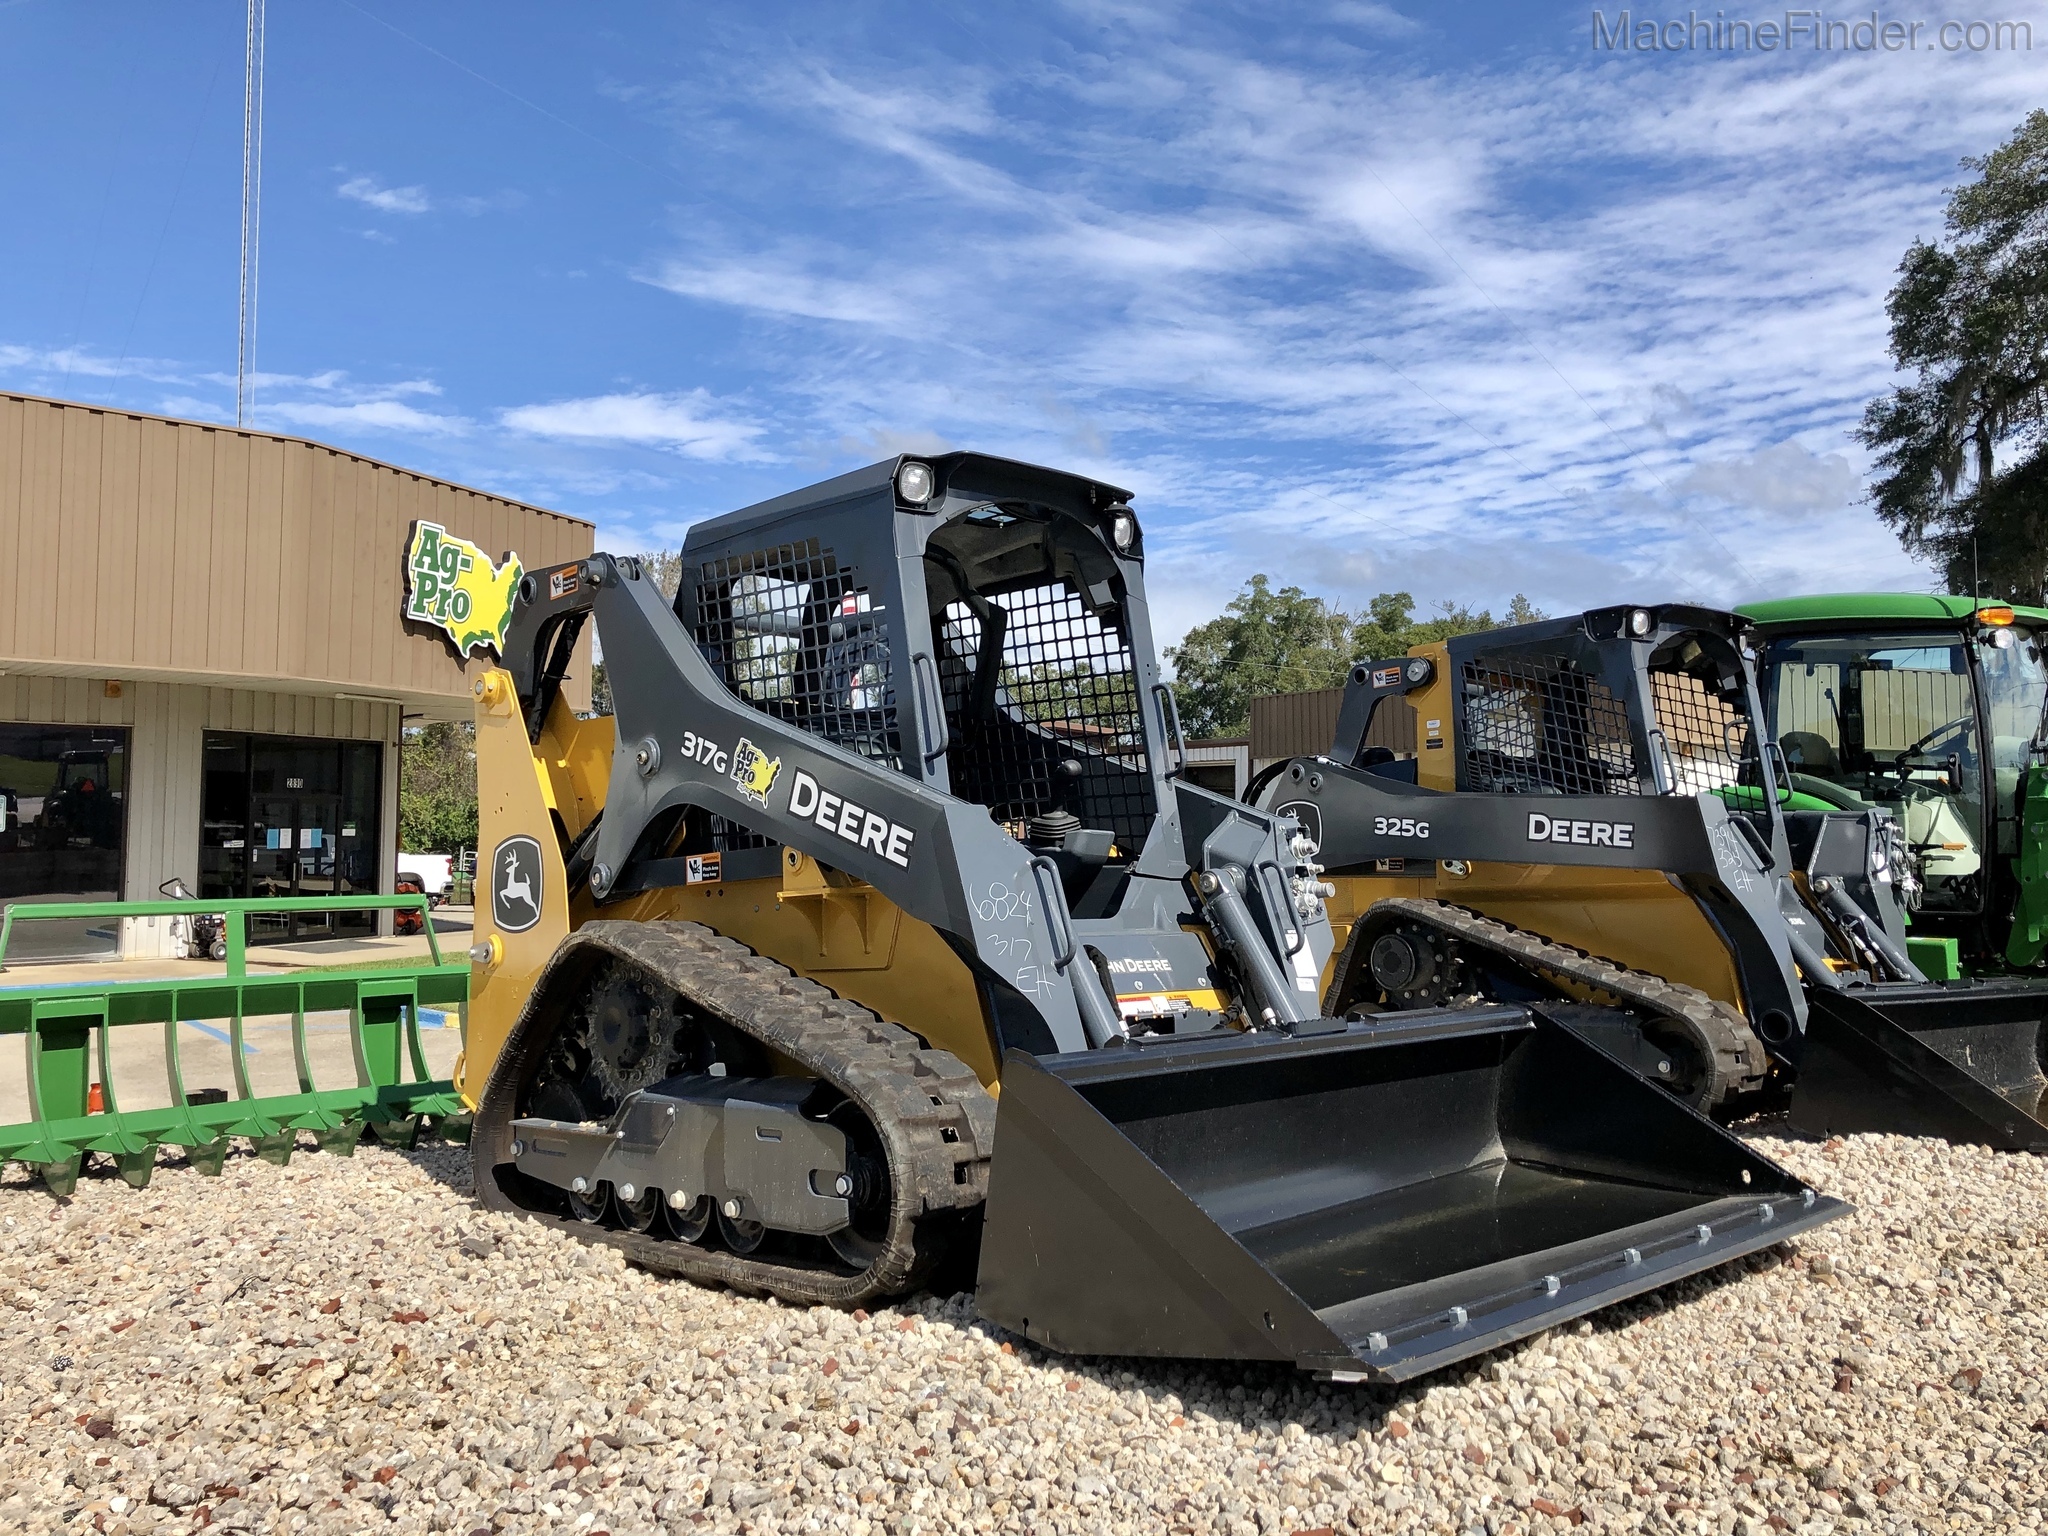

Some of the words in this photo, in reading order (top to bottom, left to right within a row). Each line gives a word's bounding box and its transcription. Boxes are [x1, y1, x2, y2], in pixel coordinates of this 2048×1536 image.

[412, 525, 474, 587] Ag-
[410, 570, 472, 622] Pro
[681, 731, 728, 774] 317G
[736, 741, 760, 768] Ag-
[733, 759, 756, 784] Pro
[789, 771, 914, 868] DEERE
[1374, 816, 1430, 838] 325G
[1528, 813, 1634, 848] DEERE
[969, 882, 1033, 928] 6824
[986, 934, 1032, 961] 317
[1015, 964, 1057, 1000] EH
[1124, 958, 1172, 973] DEERE
